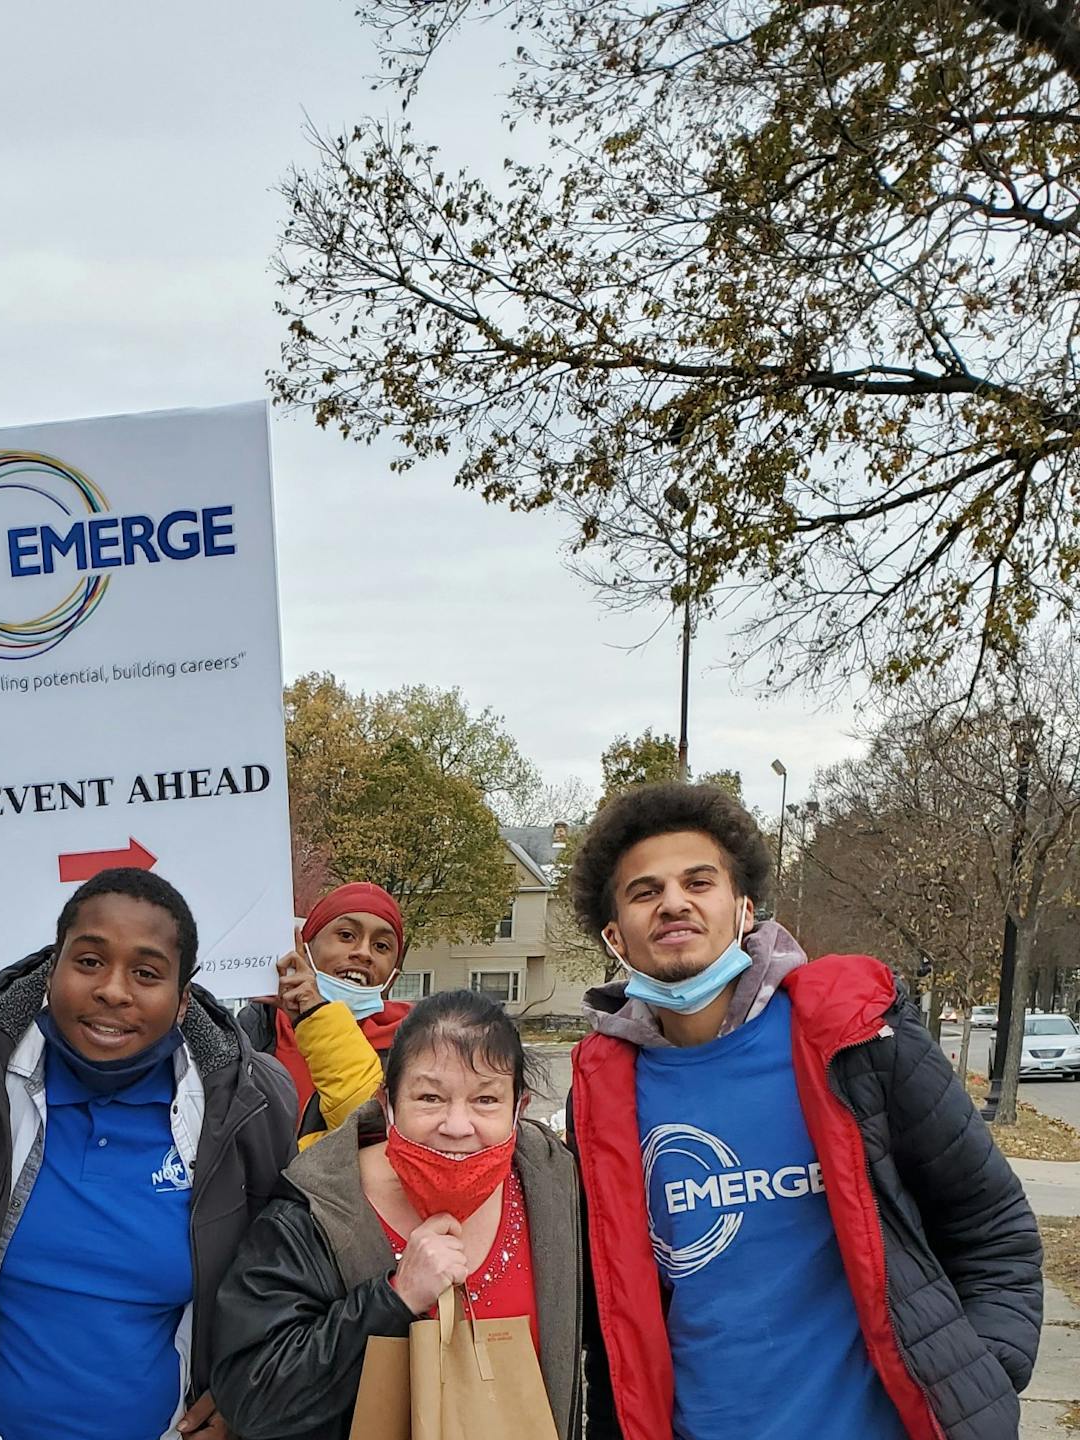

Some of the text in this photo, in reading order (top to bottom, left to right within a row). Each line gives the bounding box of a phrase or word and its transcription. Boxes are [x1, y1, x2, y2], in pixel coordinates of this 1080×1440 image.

[8, 506, 236, 577] EMERGE
[33, 666, 108, 691] potential,
[113, 659, 176, 682] building
[127, 764, 270, 804] AHEAD
[220, 956, 273, 971] 529-9267
[151, 1163, 184, 1186] NOR
[665, 1162, 826, 1214] EMERGE
